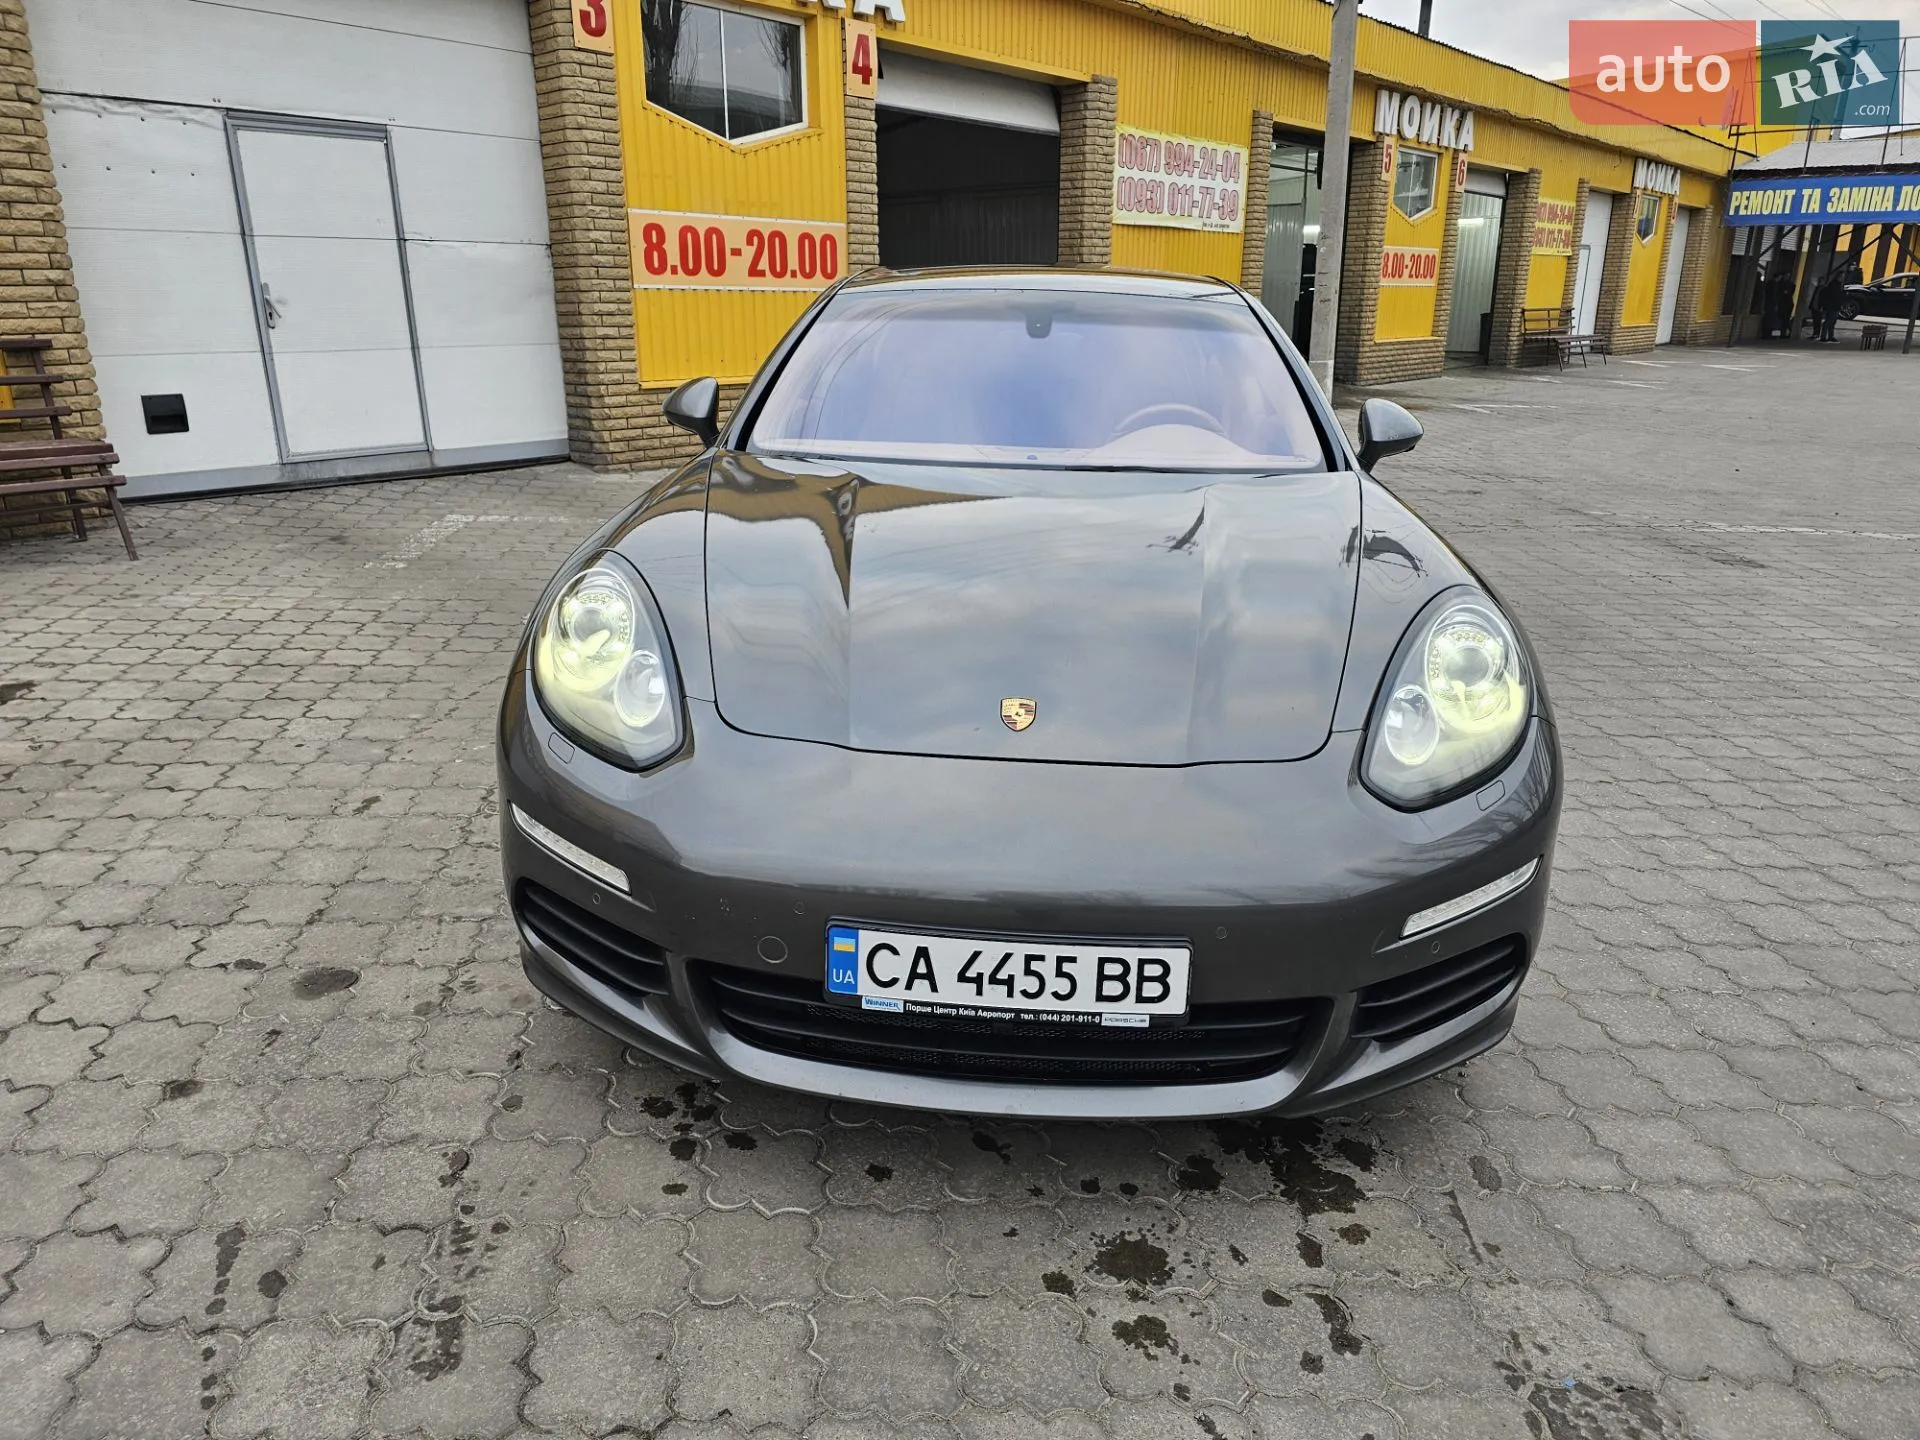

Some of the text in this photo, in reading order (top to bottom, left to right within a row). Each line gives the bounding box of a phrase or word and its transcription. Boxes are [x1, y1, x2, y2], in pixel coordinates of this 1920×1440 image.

[579, 0, 607, 38] 3
[851, 33, 873, 86] 4
[1164, 140, 1241, 184] 994-24-04
[1383, 143, 1393, 174] 5
[1457, 159, 1466, 186] 6
[1167, 181, 1240, 222] 011-77-39
[1729, 188, 1796, 216] РЕМОНТ
[1800, 188, 1821, 214] ТА
[1826, 185, 1895, 213] ЗАМІНА
[642, 221, 839, 281] 8.00-20.00
[1382, 252, 1436, 279] 8.00-20.00
[833, 968, 856, 985] UA
[866, 942, 1172, 1005] CA 4455 BB
[905, 1002, 932, 1014] Порше
[933, 1005, 957, 1016] Центр
[977, 1009, 1015, 1020] Аеропорт
